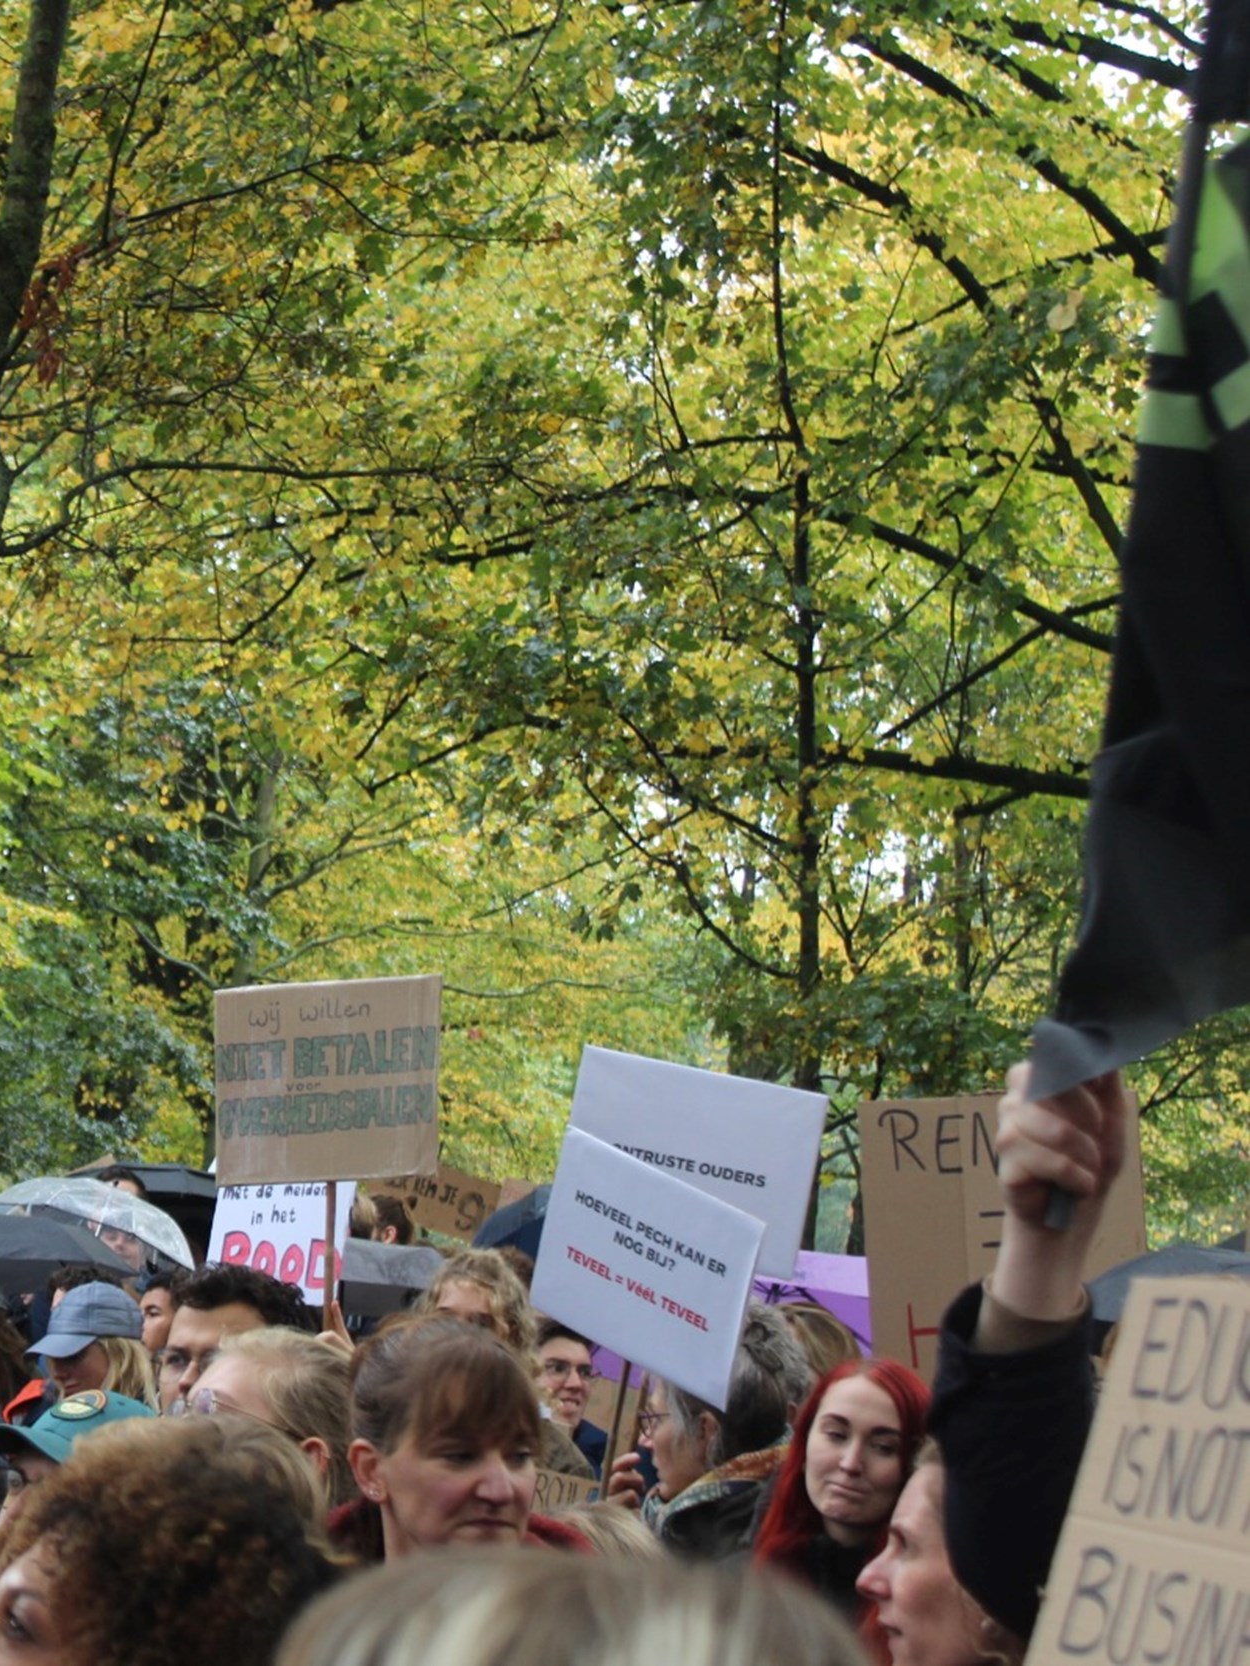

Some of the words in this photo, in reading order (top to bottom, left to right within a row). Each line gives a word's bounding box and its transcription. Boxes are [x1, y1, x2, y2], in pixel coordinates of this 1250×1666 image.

[248, 999, 281, 1035] wij
[300, 998, 371, 1024] willen
[217, 1040, 287, 1083] NIET
[293, 1026, 437, 1079] BETALEN
[286, 1081, 322, 1092] voor
[223, 1185, 249, 1200] met
[256, 1184, 274, 1198] de
[698, 1163, 766, 1188] OUDERS
[251, 1210, 263, 1226] in
[271, 1204, 296, 1224] het
[575, 1190, 633, 1230] HOEVEEL
[635, 1221, 673, 1249] PECH
[674, 1241, 706, 1266] KAN
[707, 1257, 727, 1277] ER
[613, 1230, 643, 1255] NOG
[646, 1248, 676, 1272] BIJ?
[566, 1246, 612, 1281] TEVEEL
[660, 1296, 709, 1332] TEVEEL
